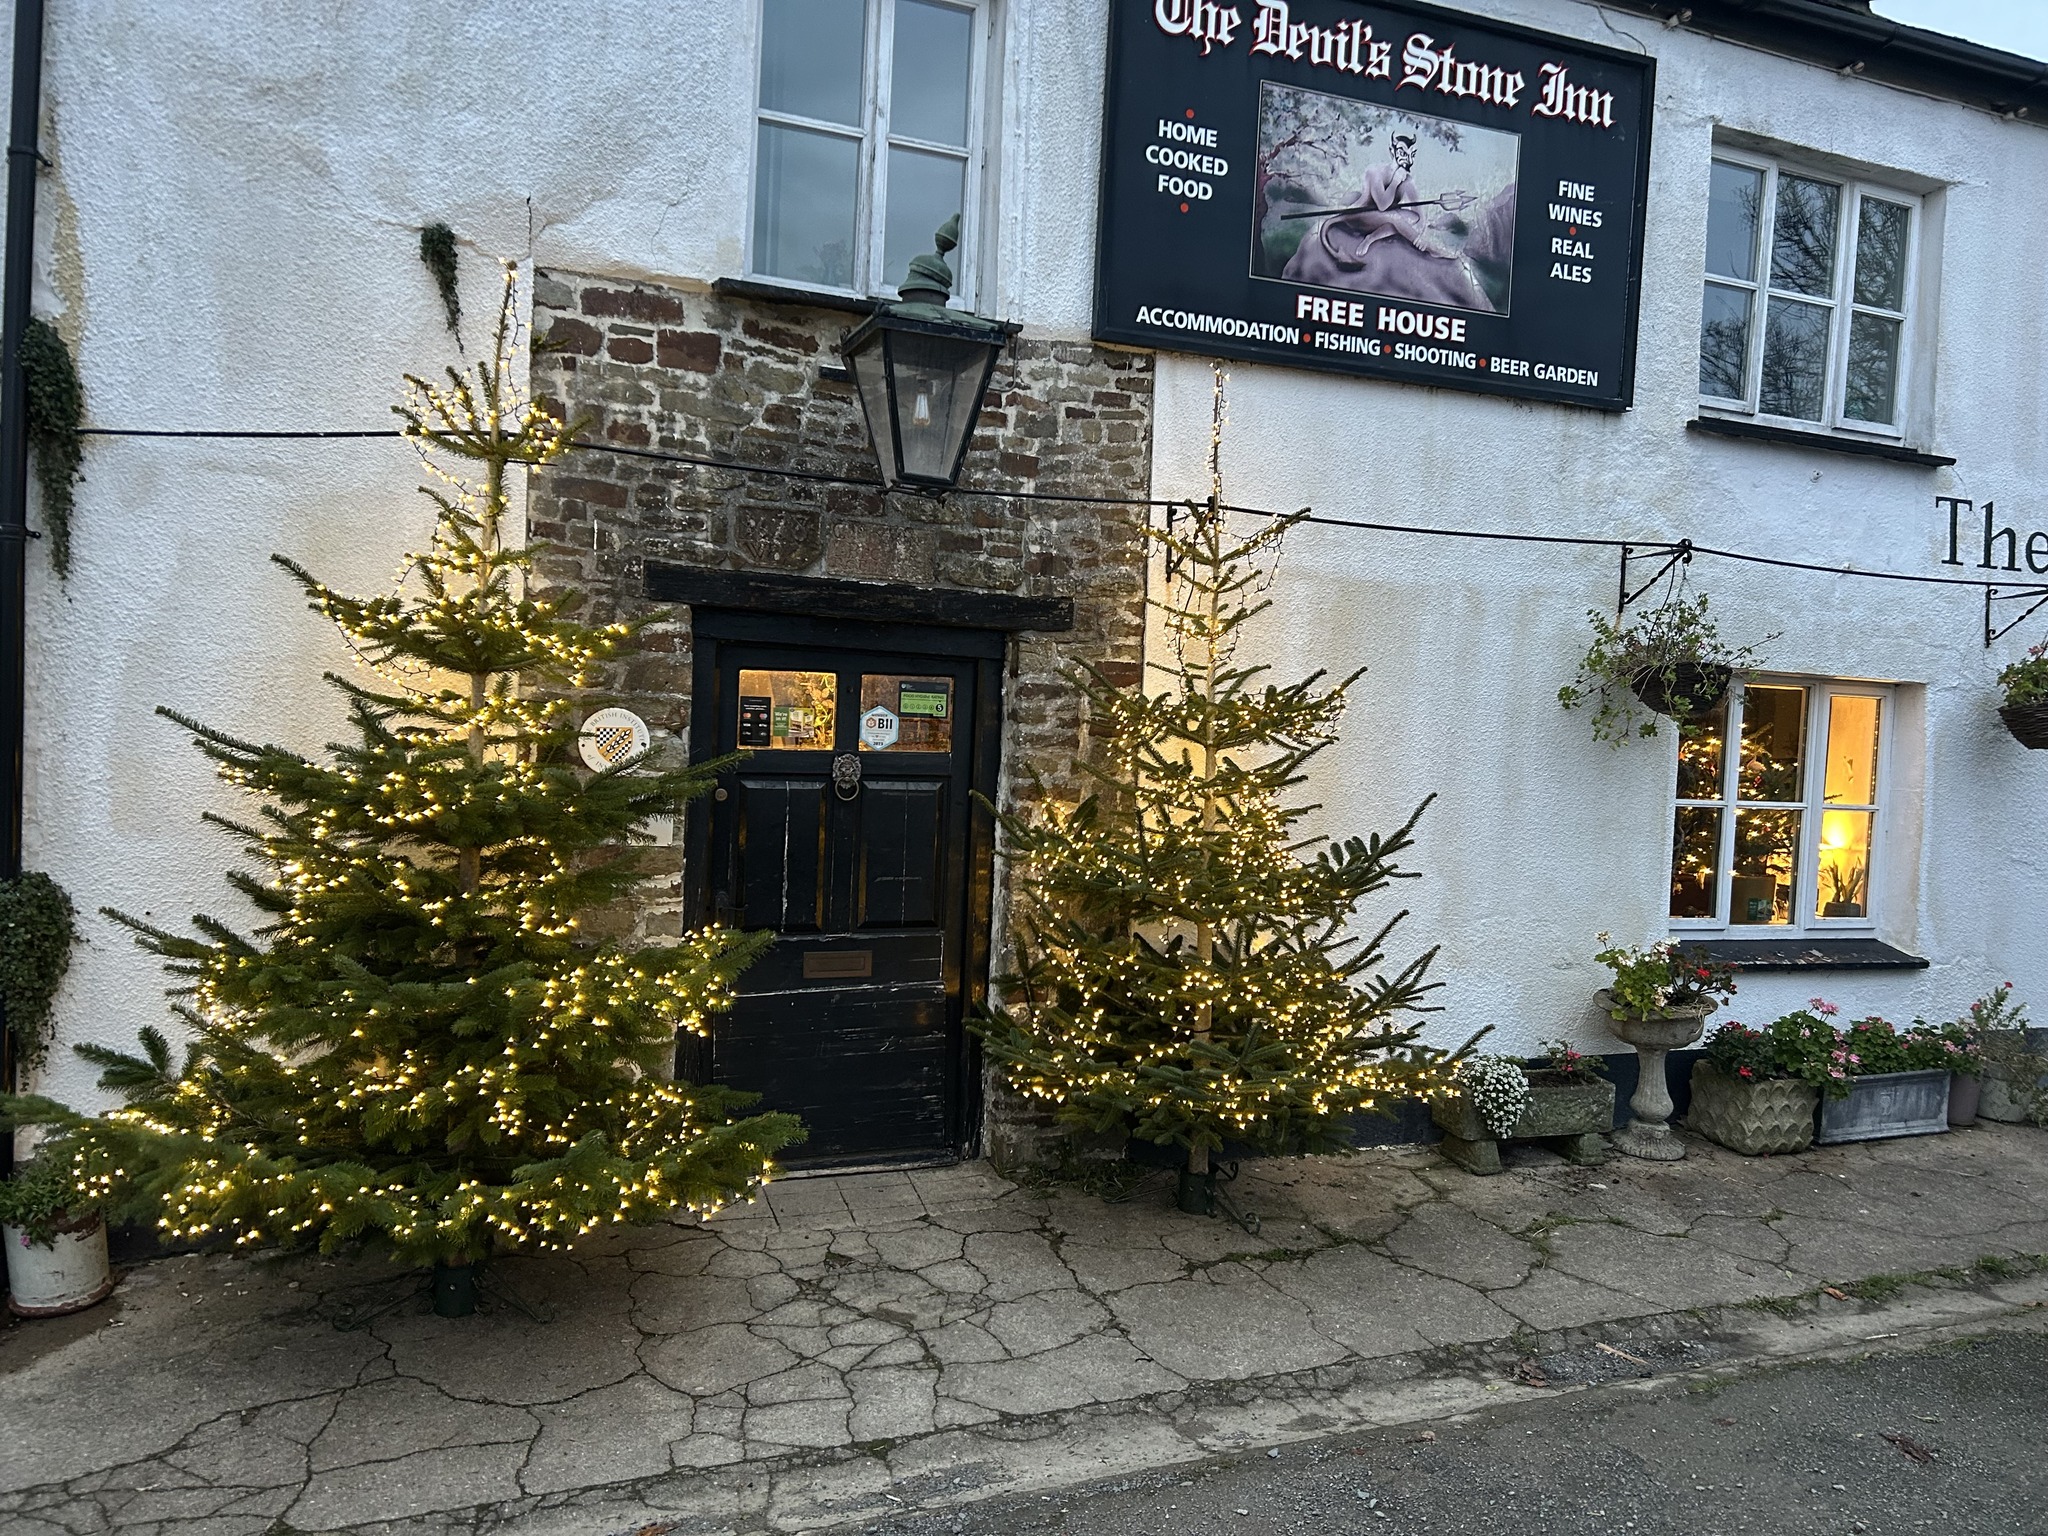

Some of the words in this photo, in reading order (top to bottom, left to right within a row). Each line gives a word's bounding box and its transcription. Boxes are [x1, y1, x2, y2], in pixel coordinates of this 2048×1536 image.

[1154, 0, 1242, 56] The
[1250, 0, 1392, 79] Devil's
[1396, 33, 1525, 109] Stone
[1532, 61, 1616, 128] Inn
[1158, 119, 1218, 148] HOME
[1145, 144, 1229, 177] COOKED
[1157, 174, 1213, 201] FOOD
[1558, 180, 1595, 202] FINE
[1548, 203, 1603, 228] WINES
[1551, 237, 1594, 260] REAL
[1549, 262, 1592, 284] ALES
[1296, 294, 1364, 328] FREE
[1377, 306, 1466, 343] HOUSE
[1136, 306, 1300, 345] ACCOMMODATION
[1314, 331, 1381, 357] FISHING
[1394, 342, 1477, 370] SHOOTING
[1490, 356, 1529, 377] BEER
[1533, 363, 1599, 387] GARDEN
[1935, 496, 2048, 574] The
[590, 711, 618, 727] BRITISH
[877, 718, 893, 730] BII
